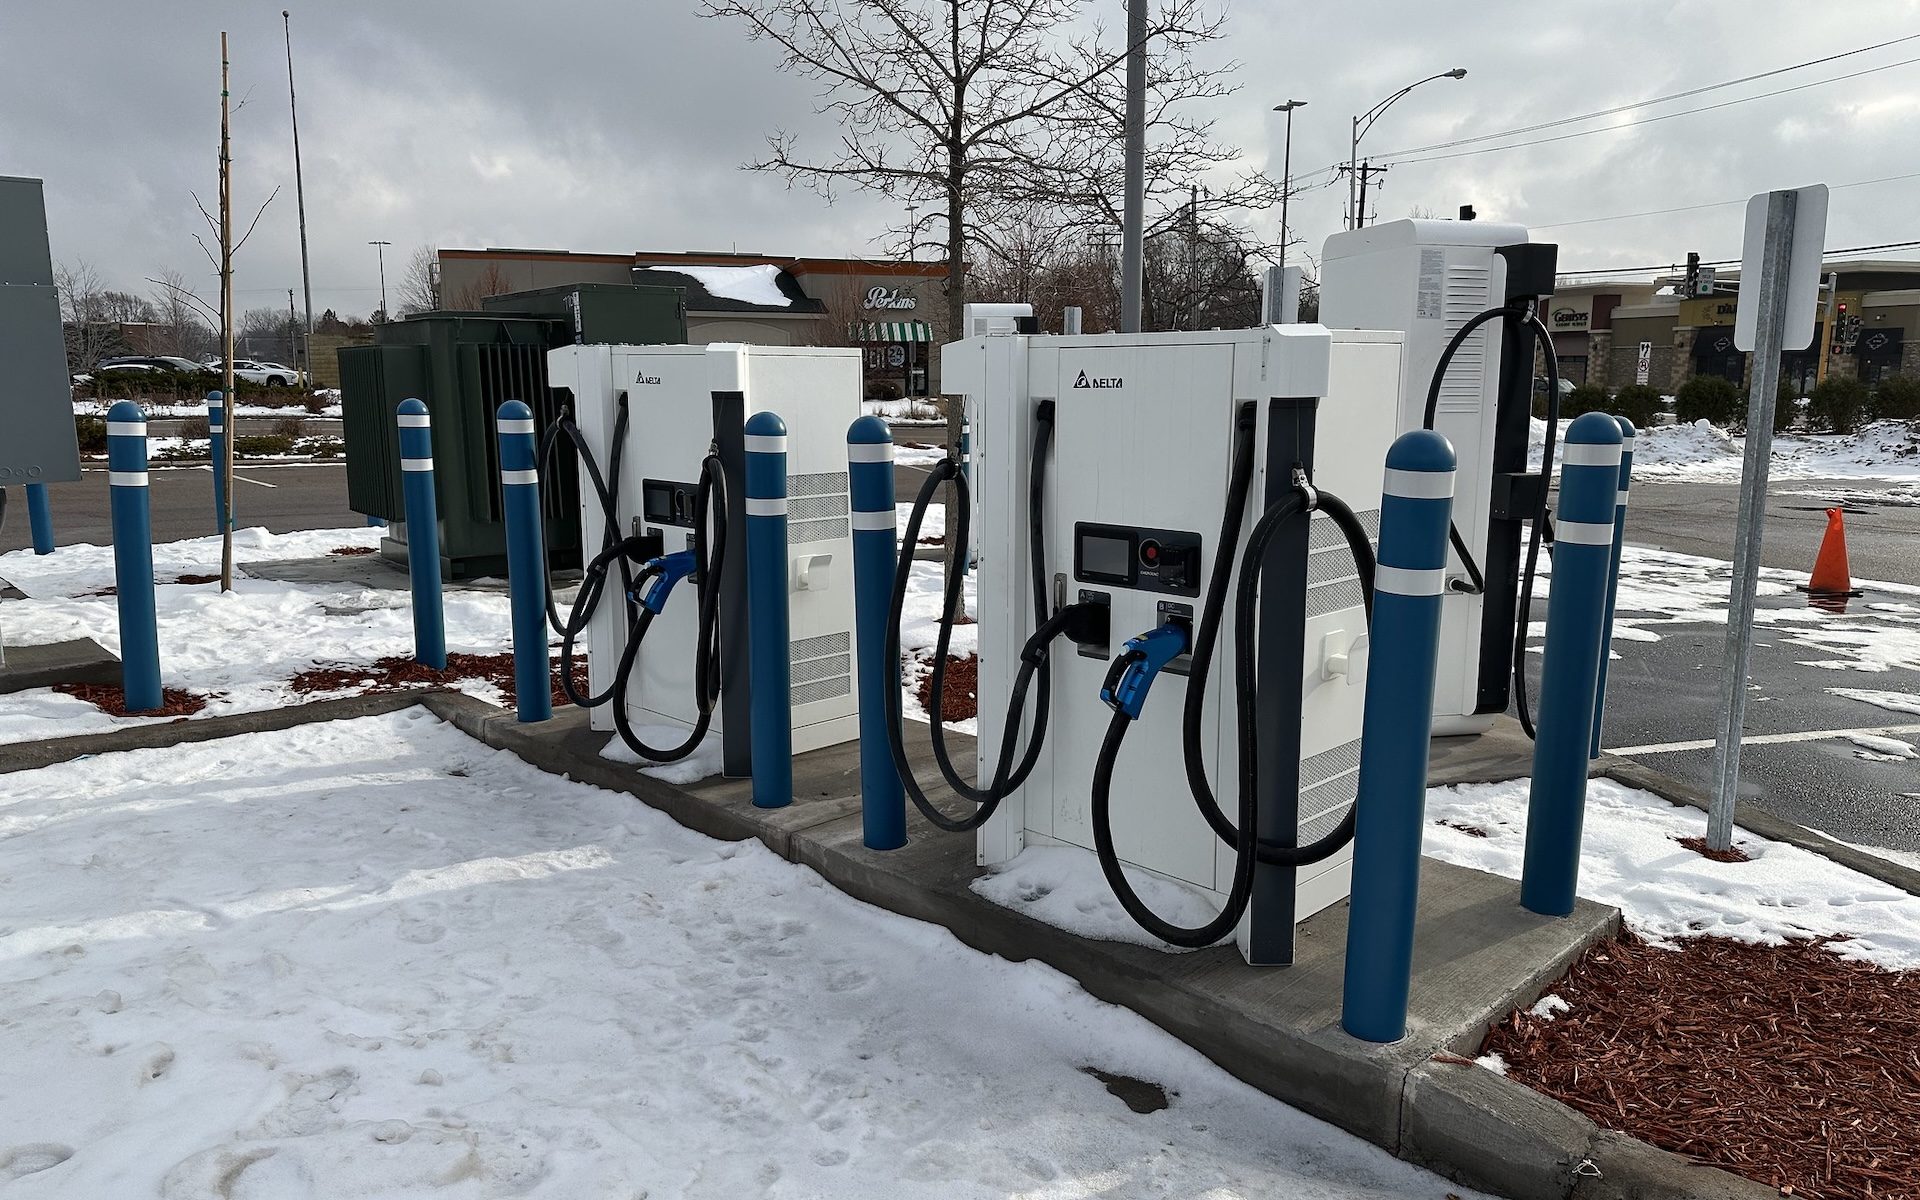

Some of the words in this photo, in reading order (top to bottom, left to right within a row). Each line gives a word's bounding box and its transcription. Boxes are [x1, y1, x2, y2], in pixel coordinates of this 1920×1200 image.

[863, 286, 917, 310] Perkins
[889, 348, 904, 358] 24
[1092, 377, 1123, 389] DELTA
